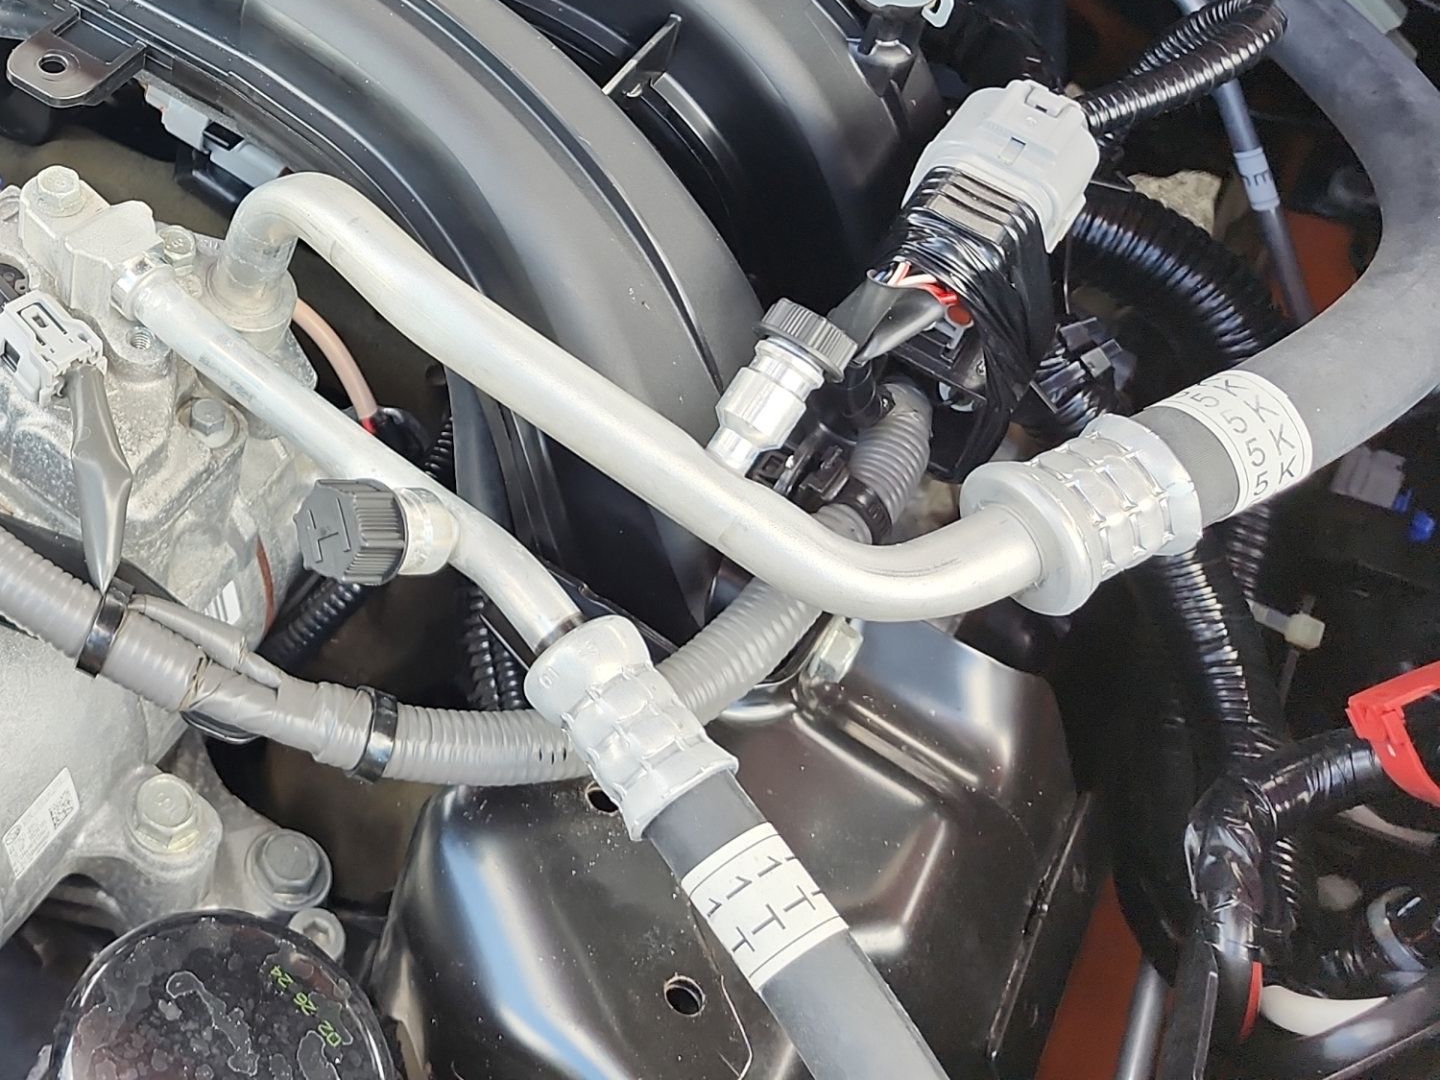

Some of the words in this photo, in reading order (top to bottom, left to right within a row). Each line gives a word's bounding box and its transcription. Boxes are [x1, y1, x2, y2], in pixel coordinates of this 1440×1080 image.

[270, 965, 294, 988] 24
[293, 992, 317, 1016] 26
[318, 1020, 342, 1048] 02
